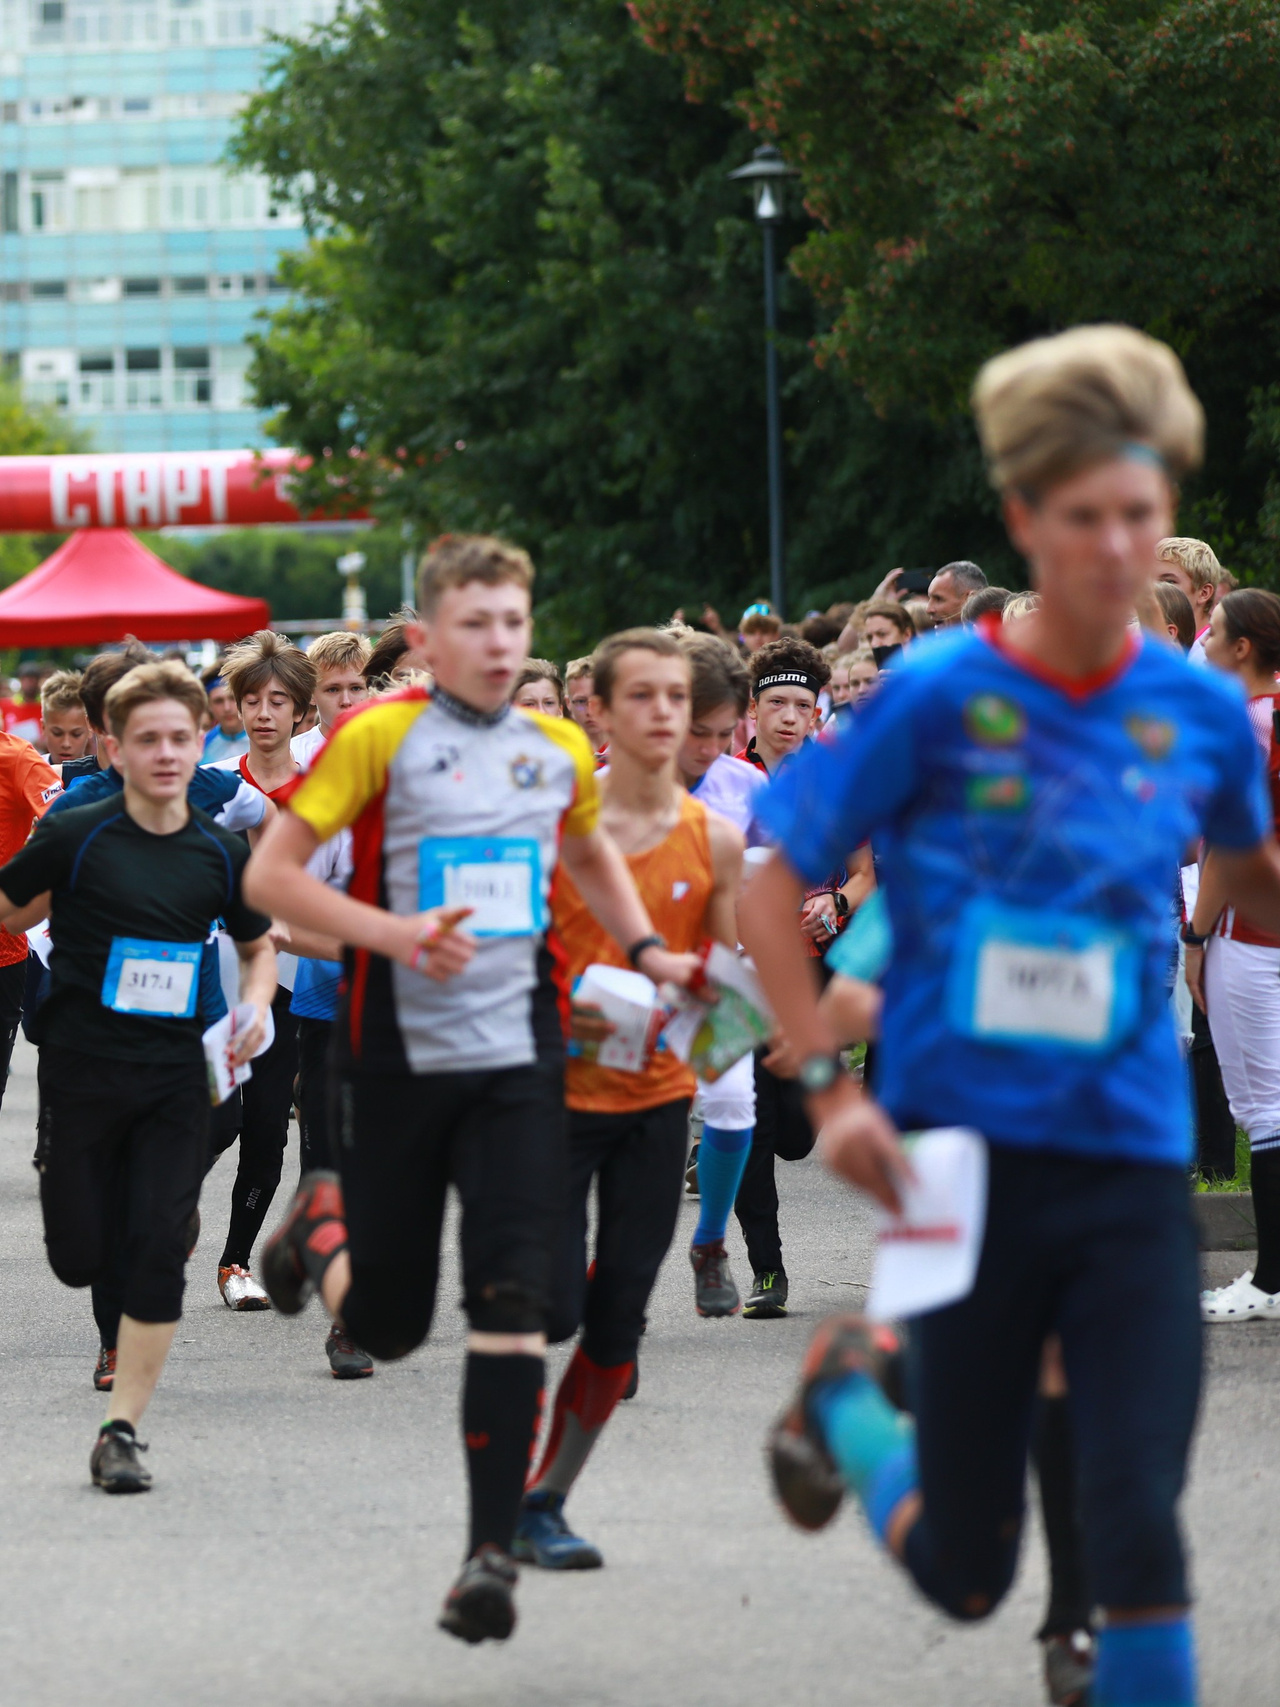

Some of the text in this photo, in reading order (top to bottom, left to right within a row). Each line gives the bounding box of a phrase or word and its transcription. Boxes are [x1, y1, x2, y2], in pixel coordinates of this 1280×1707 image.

[50, 456, 238, 528] СТАРТ
[758, 673, 808, 687] noname
[127, 972, 173, 990] 317.1
